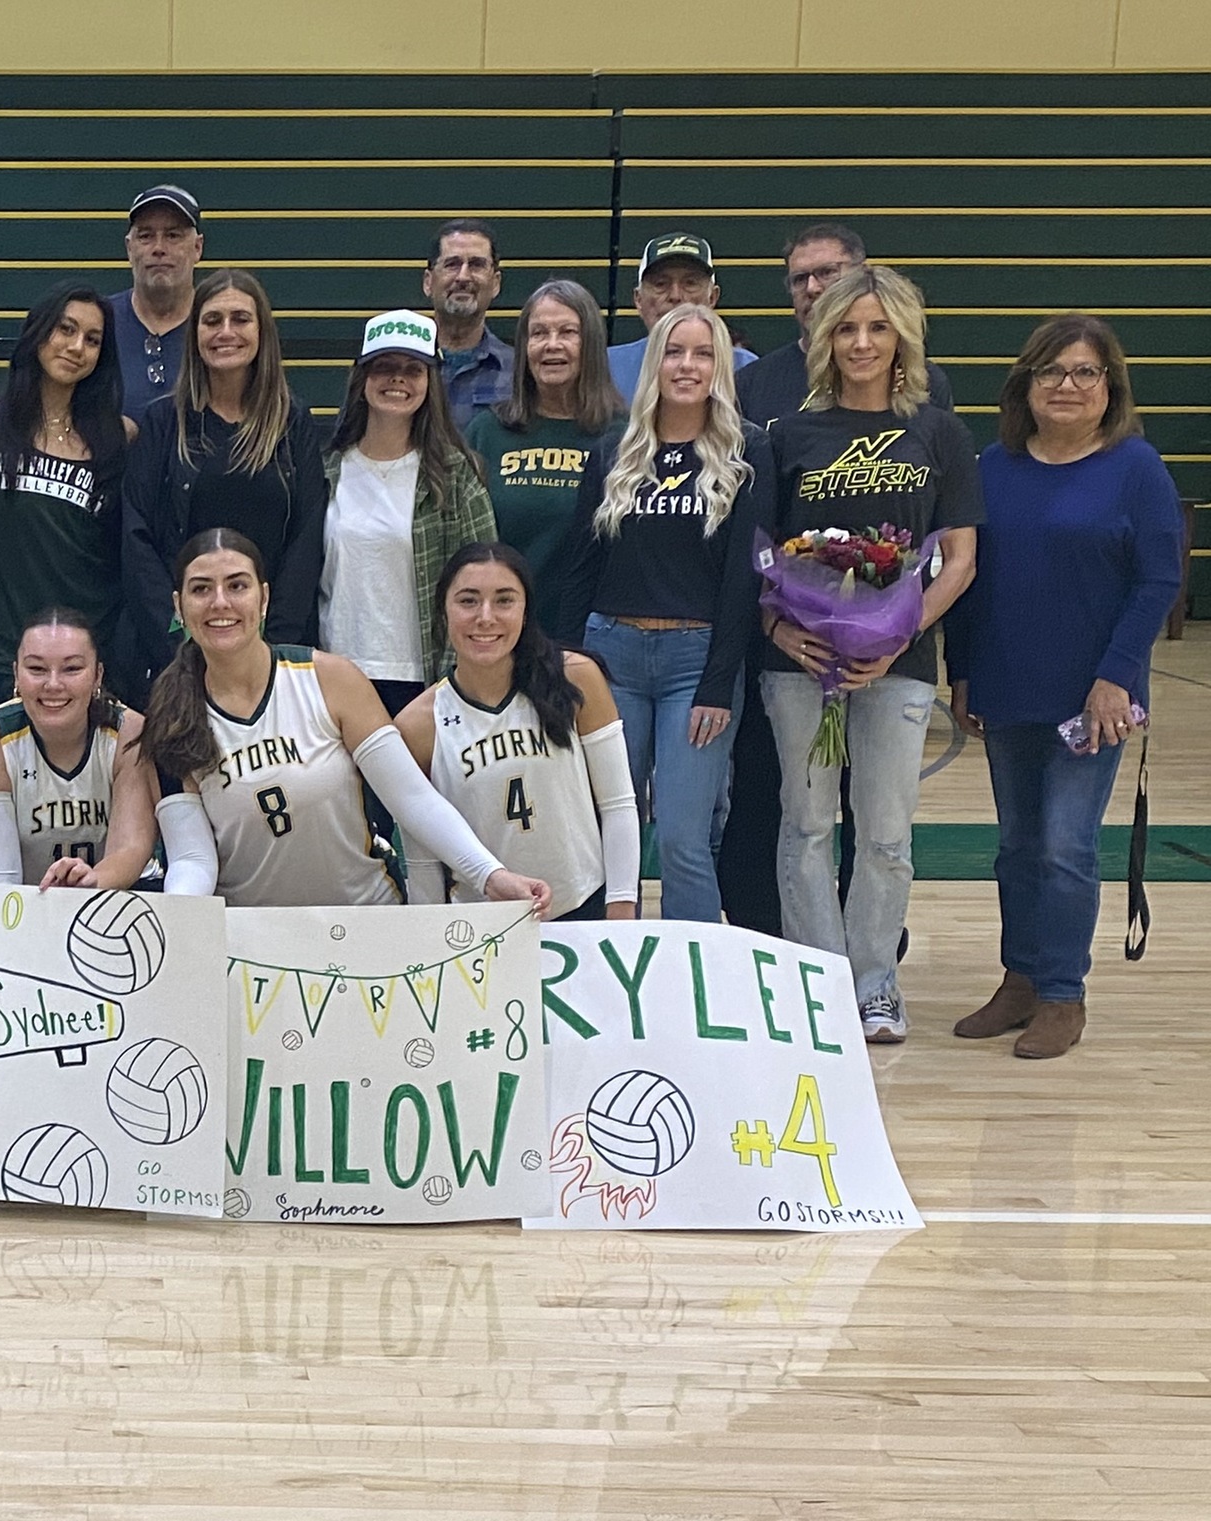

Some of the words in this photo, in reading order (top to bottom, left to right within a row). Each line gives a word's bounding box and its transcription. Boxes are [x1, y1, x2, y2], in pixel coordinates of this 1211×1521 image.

[367, 321, 432, 342] STORMS
[499, 448, 590, 476] STOR
[504, 477, 529, 486] NAPA
[531, 477, 566, 487] VALLEY
[799, 463, 931, 498] STORM
[807, 485, 914, 502] VOLLEYBALL
[218, 736, 304, 790] STORM
[461, 728, 551, 779] STORM
[30, 799, 109, 835] STORM
[254, 784, 293, 839] 8
[504, 774, 536, 833] 4
[540, 935, 843, 1055] RYLEE
[466, 999, 528, 1061] #8
[730, 1073, 843, 1208] #4
[137, 1160, 162, 1176] GO
[136, 1184, 220, 1208] STORMS!
[276, 1192, 385, 1221] Sophmore
